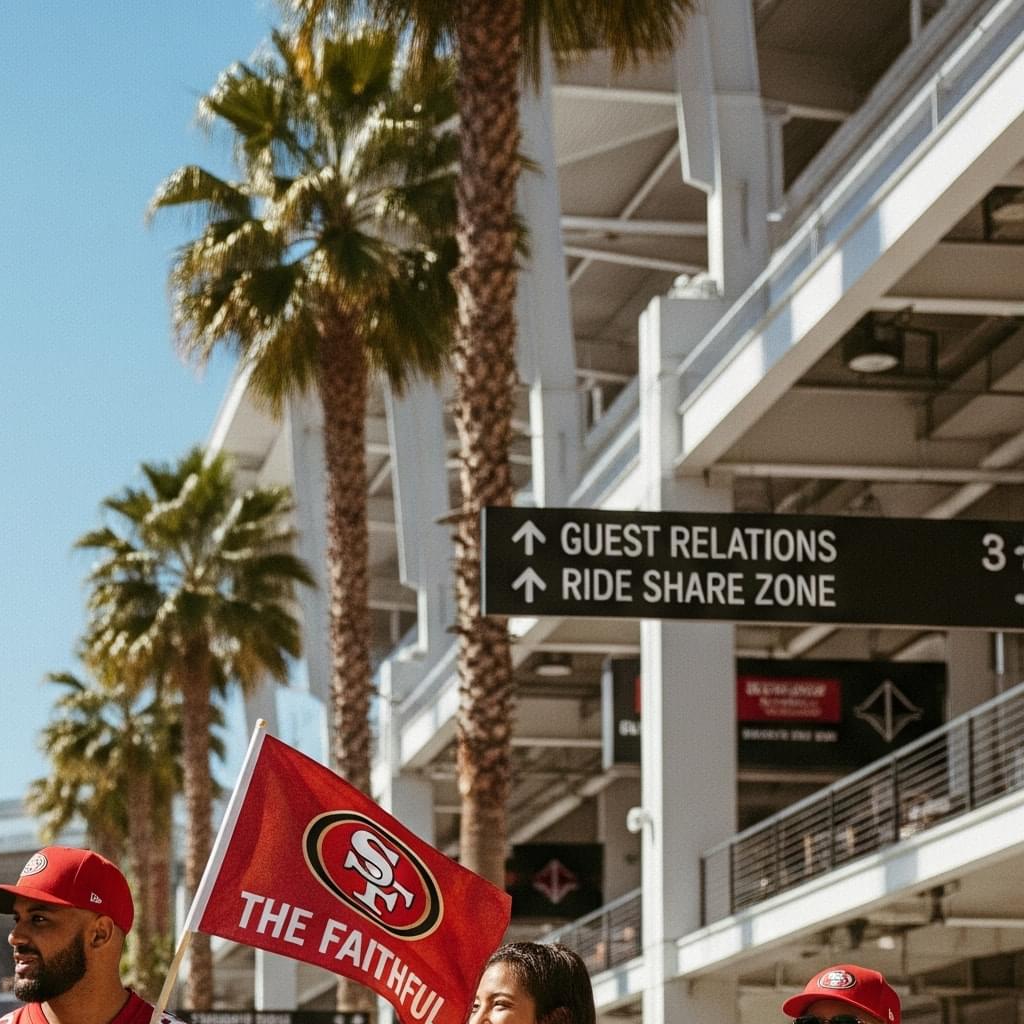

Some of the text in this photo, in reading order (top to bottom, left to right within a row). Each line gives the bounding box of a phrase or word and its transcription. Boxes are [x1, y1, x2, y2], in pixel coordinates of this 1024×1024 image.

[560, 522, 661, 557] GUEST
[670, 526, 837, 562] RELATIONS
[562, 568, 836, 607] RIDE SHARE ZONE
[238, 890, 314, 947] THE
